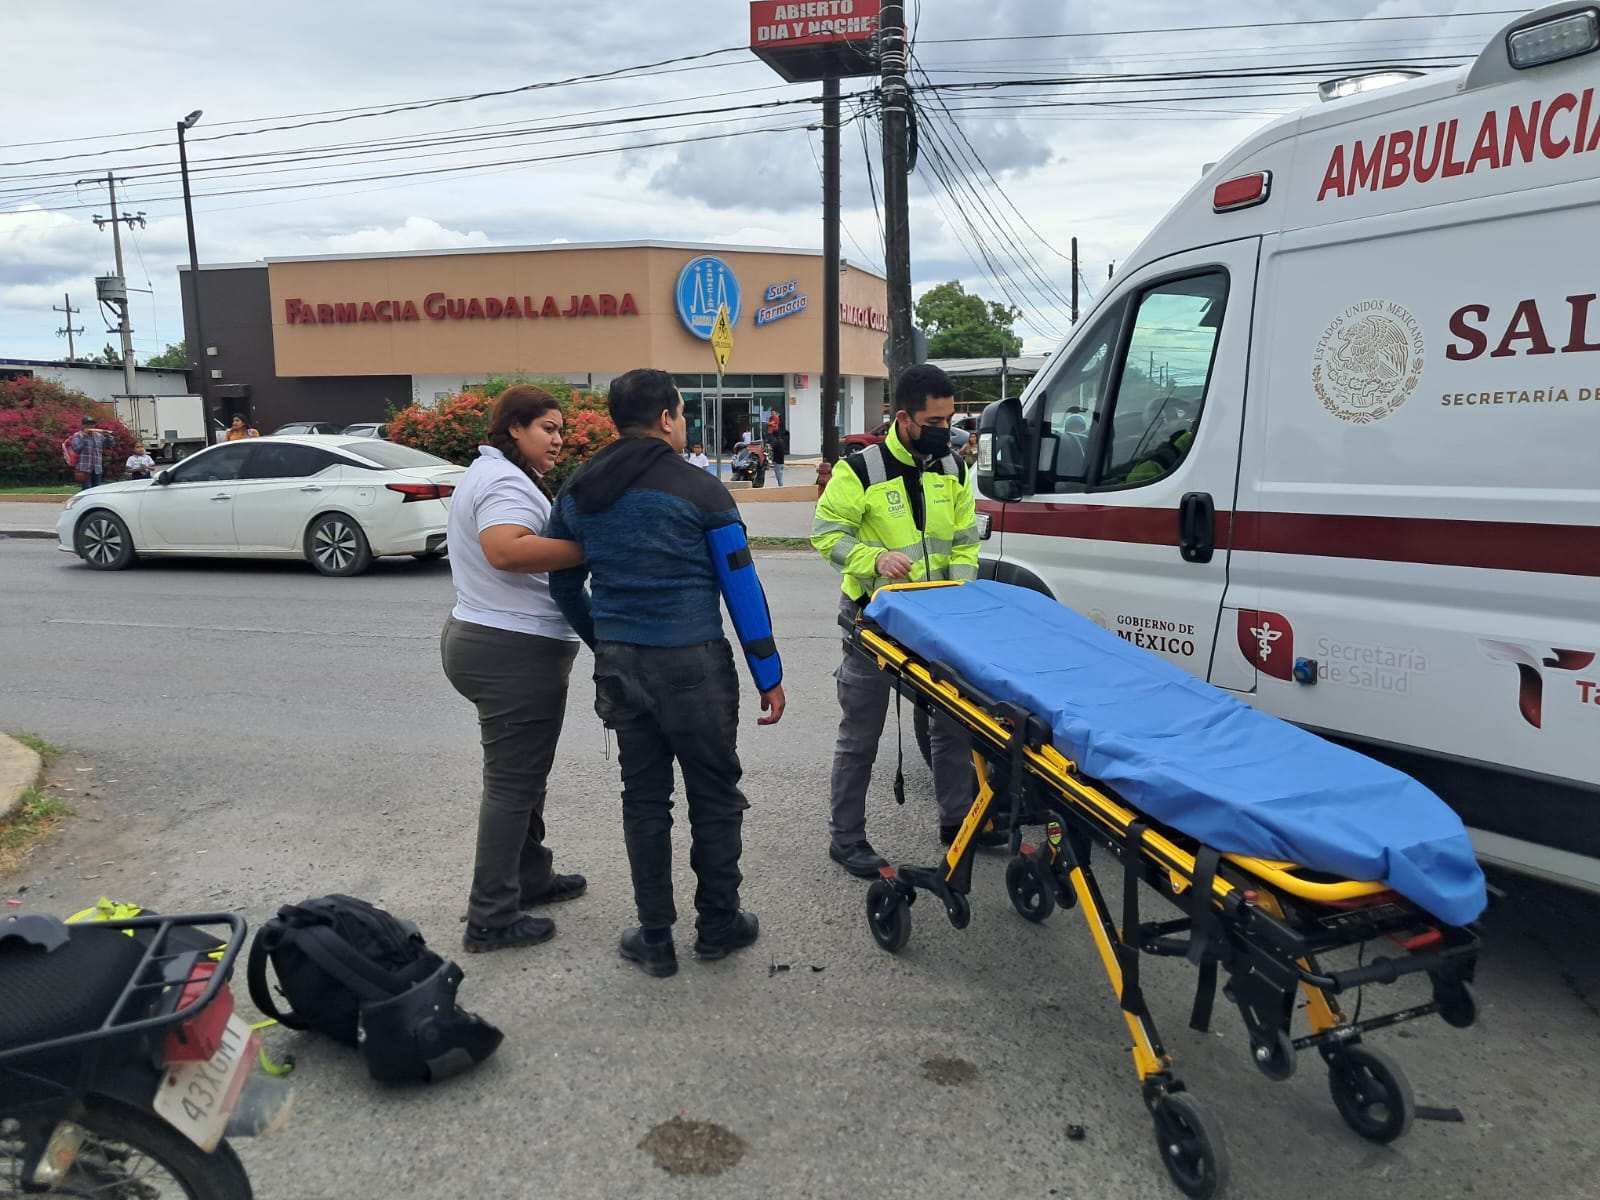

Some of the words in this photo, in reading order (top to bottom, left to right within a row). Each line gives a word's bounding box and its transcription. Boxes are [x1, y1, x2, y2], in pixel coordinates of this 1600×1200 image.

[775, 0, 853, 20] ABIERTO
[757, 24, 789, 41] DIA
[793, 22, 804, 36] Y
[808, 16, 870, 36] NOCHE
[285, 298, 419, 325] FARMACIA
[423, 292, 640, 320] GUADALAJARA
[1313, 315, 1344, 361] ESTADOS
[1345, 300, 1385, 318] UNIDOS
[1388, 302, 1425, 355] MEXICANOS
[1441, 386, 1569, 406] SECRETARÍA
[1117, 614, 1175, 632] GOBIERNO
[1178, 623, 1195, 635] DE
[1318, 638, 1426, 671] Secretaría
[1318, 660, 1341, 682] de
[1348, 666, 1408, 693] Salud
